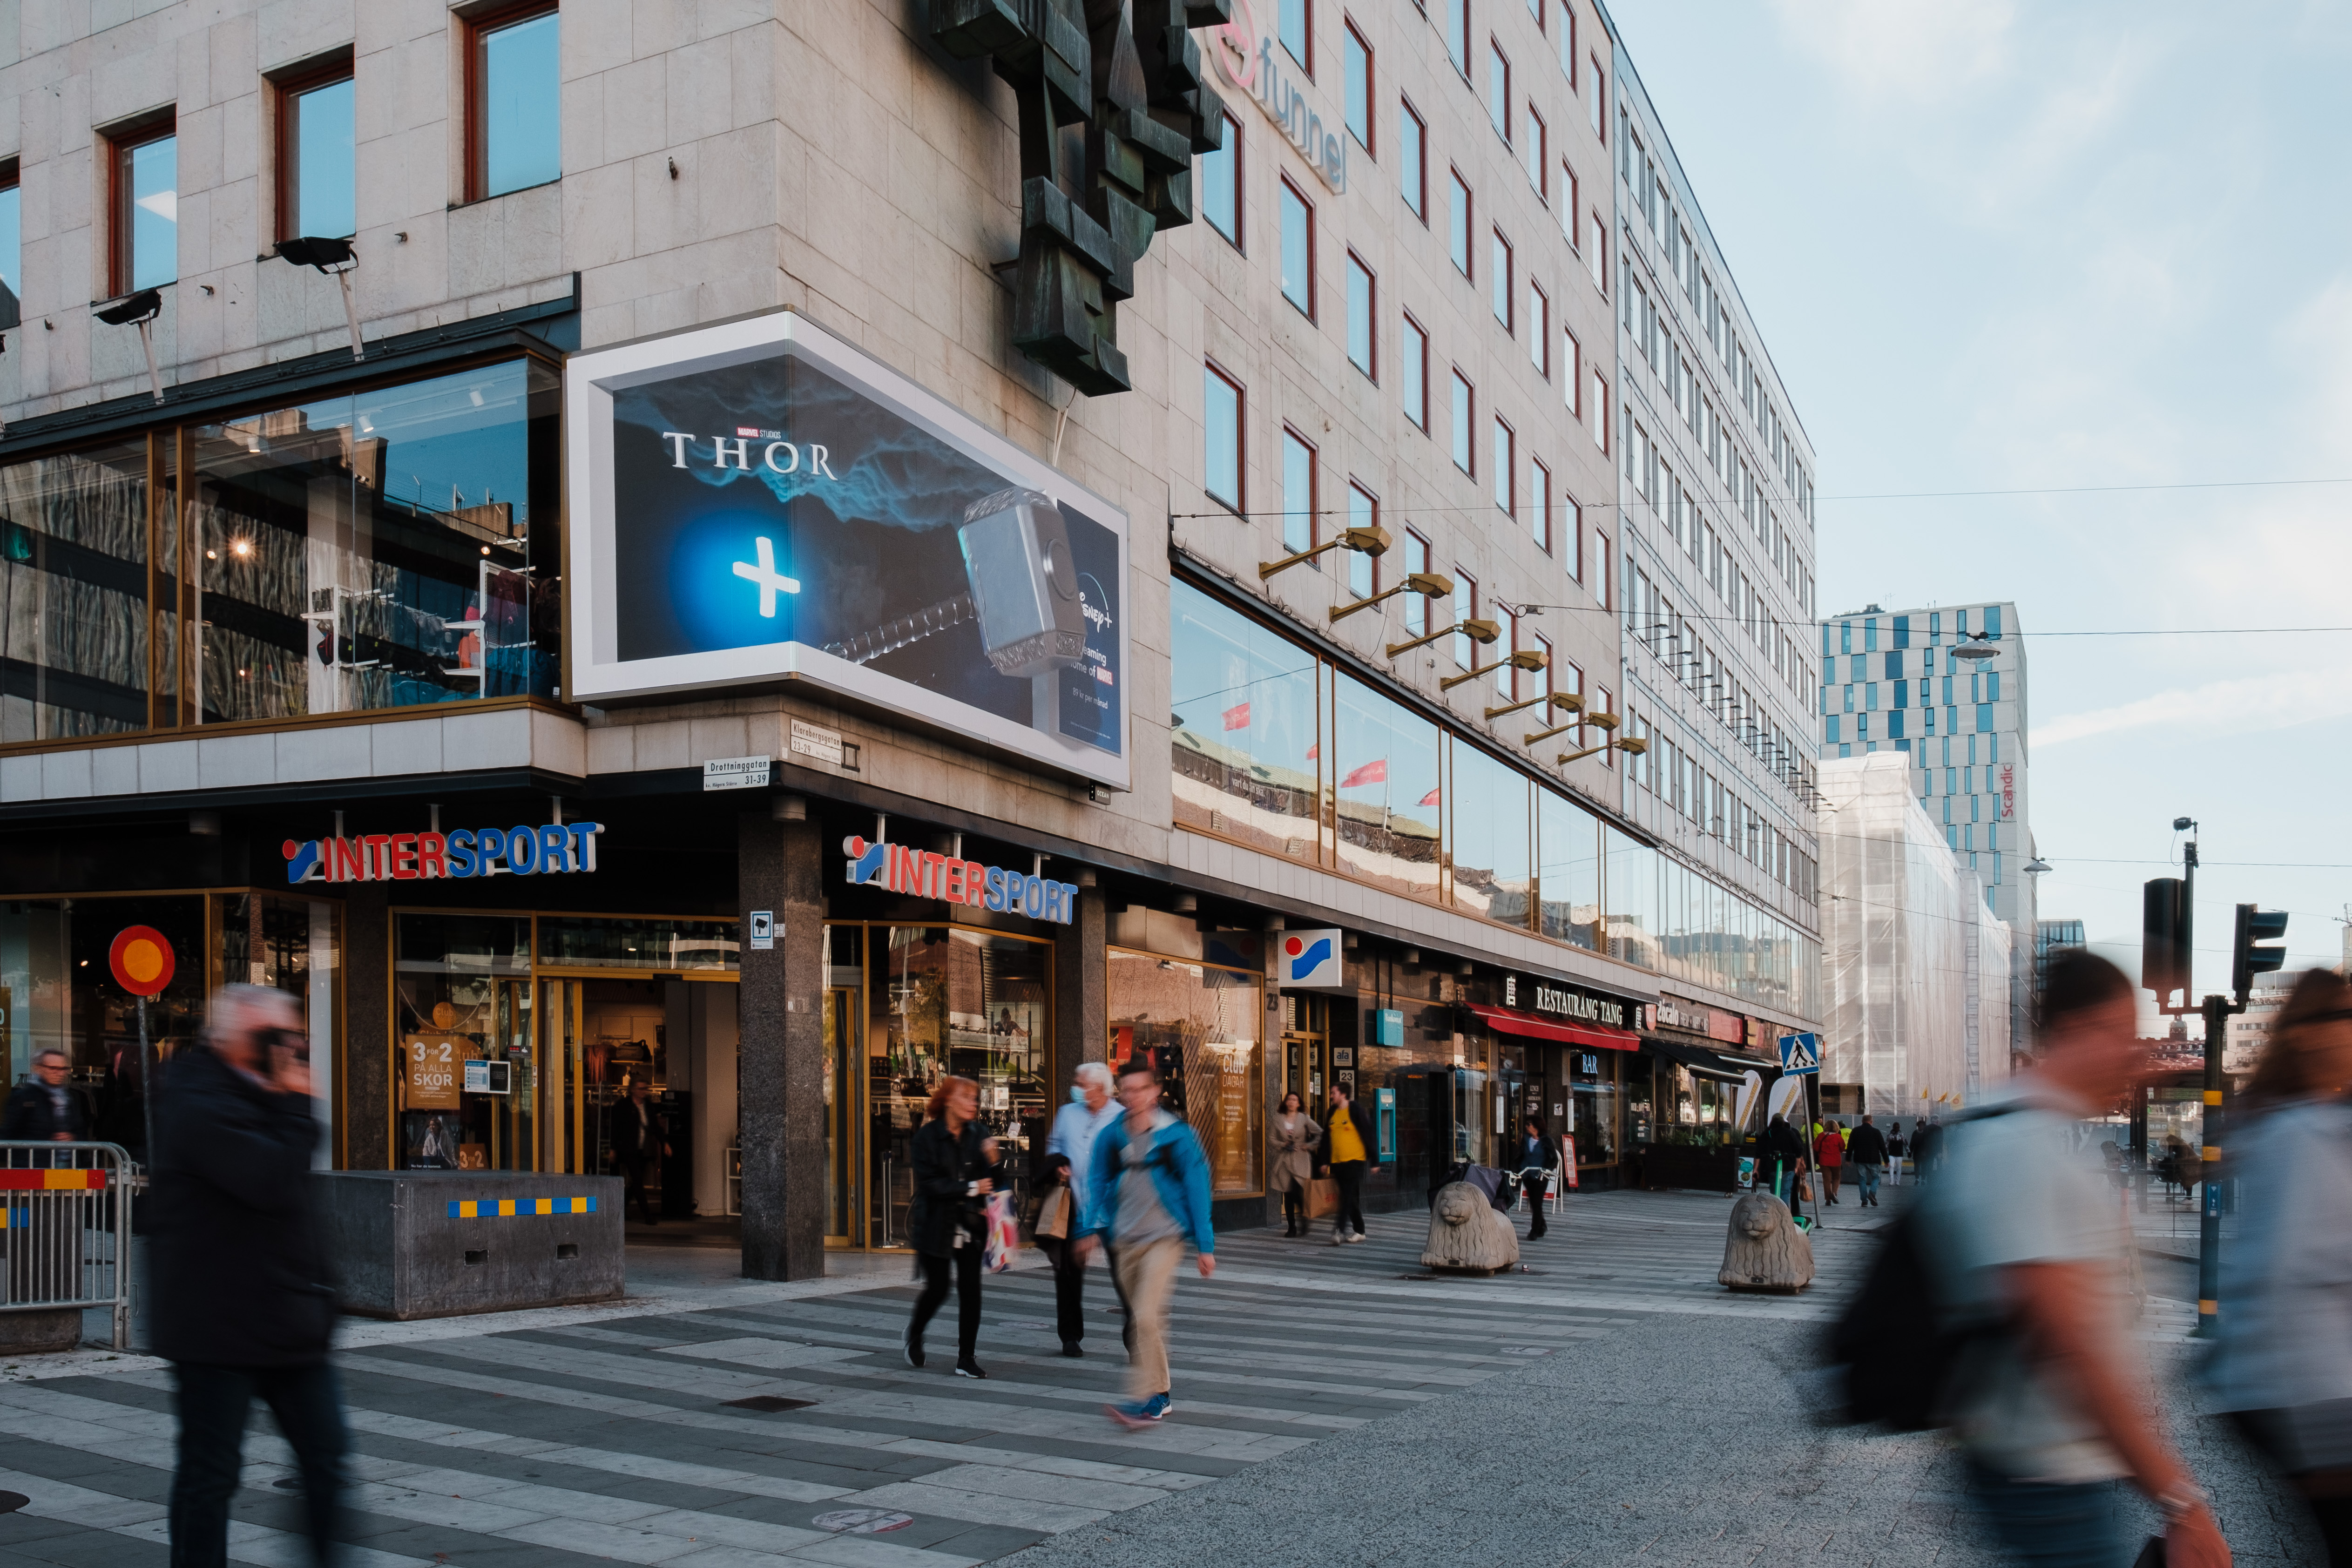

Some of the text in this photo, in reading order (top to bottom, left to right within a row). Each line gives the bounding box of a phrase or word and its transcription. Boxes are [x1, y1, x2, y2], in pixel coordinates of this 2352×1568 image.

[1260, 37, 1346, 195] funnel
[737, 427, 781, 439] MARVEL STUDIOS
[663, 432, 838, 481] THOR
[1083, 645, 1107, 667] eaming
[1088, 665, 1096, 677] of
[1097, 666, 1113, 686] MARVEL
[1073, 687, 1079, 696] 89
[1079, 689, 1084, 699] kr
[1094, 697, 1108, 709] månad
[793, 723, 840, 746] Klarabergsgatan
[793, 740, 811, 754] 23-29
[711, 760, 767, 771] Drottninggatan
[745, 774, 766, 784] 31-39
[1097, 790, 1109, 799] OCEAN
[2001, 764, 2014, 817] Scandic
[324, 822, 598, 882] INTERSPORT
[889, 843, 1078, 925] INTERSPORT
[1506, 976, 1516, 1007] 唐
[436, 1008, 454, 1016] Club
[1537, 987, 1597, 1021] RESTAURANG
[1600, 1000, 1622, 1025] TANG
[413, 1042, 426, 1061] 3
[439, 1042, 452, 1062] 2
[414, 1061, 452, 1073] PÅ ALLA
[1223, 1054, 1244, 1074] Club
[1583, 1054, 1598, 1075] BAR
[413, 1073, 453, 1086] SKOR
[1223, 1074, 1244, 1088] DAGAR
[1341, 1072, 1353, 1081] 23
[460, 1150, 468, 1168] 3
[475, 1150, 484, 1168] 2
